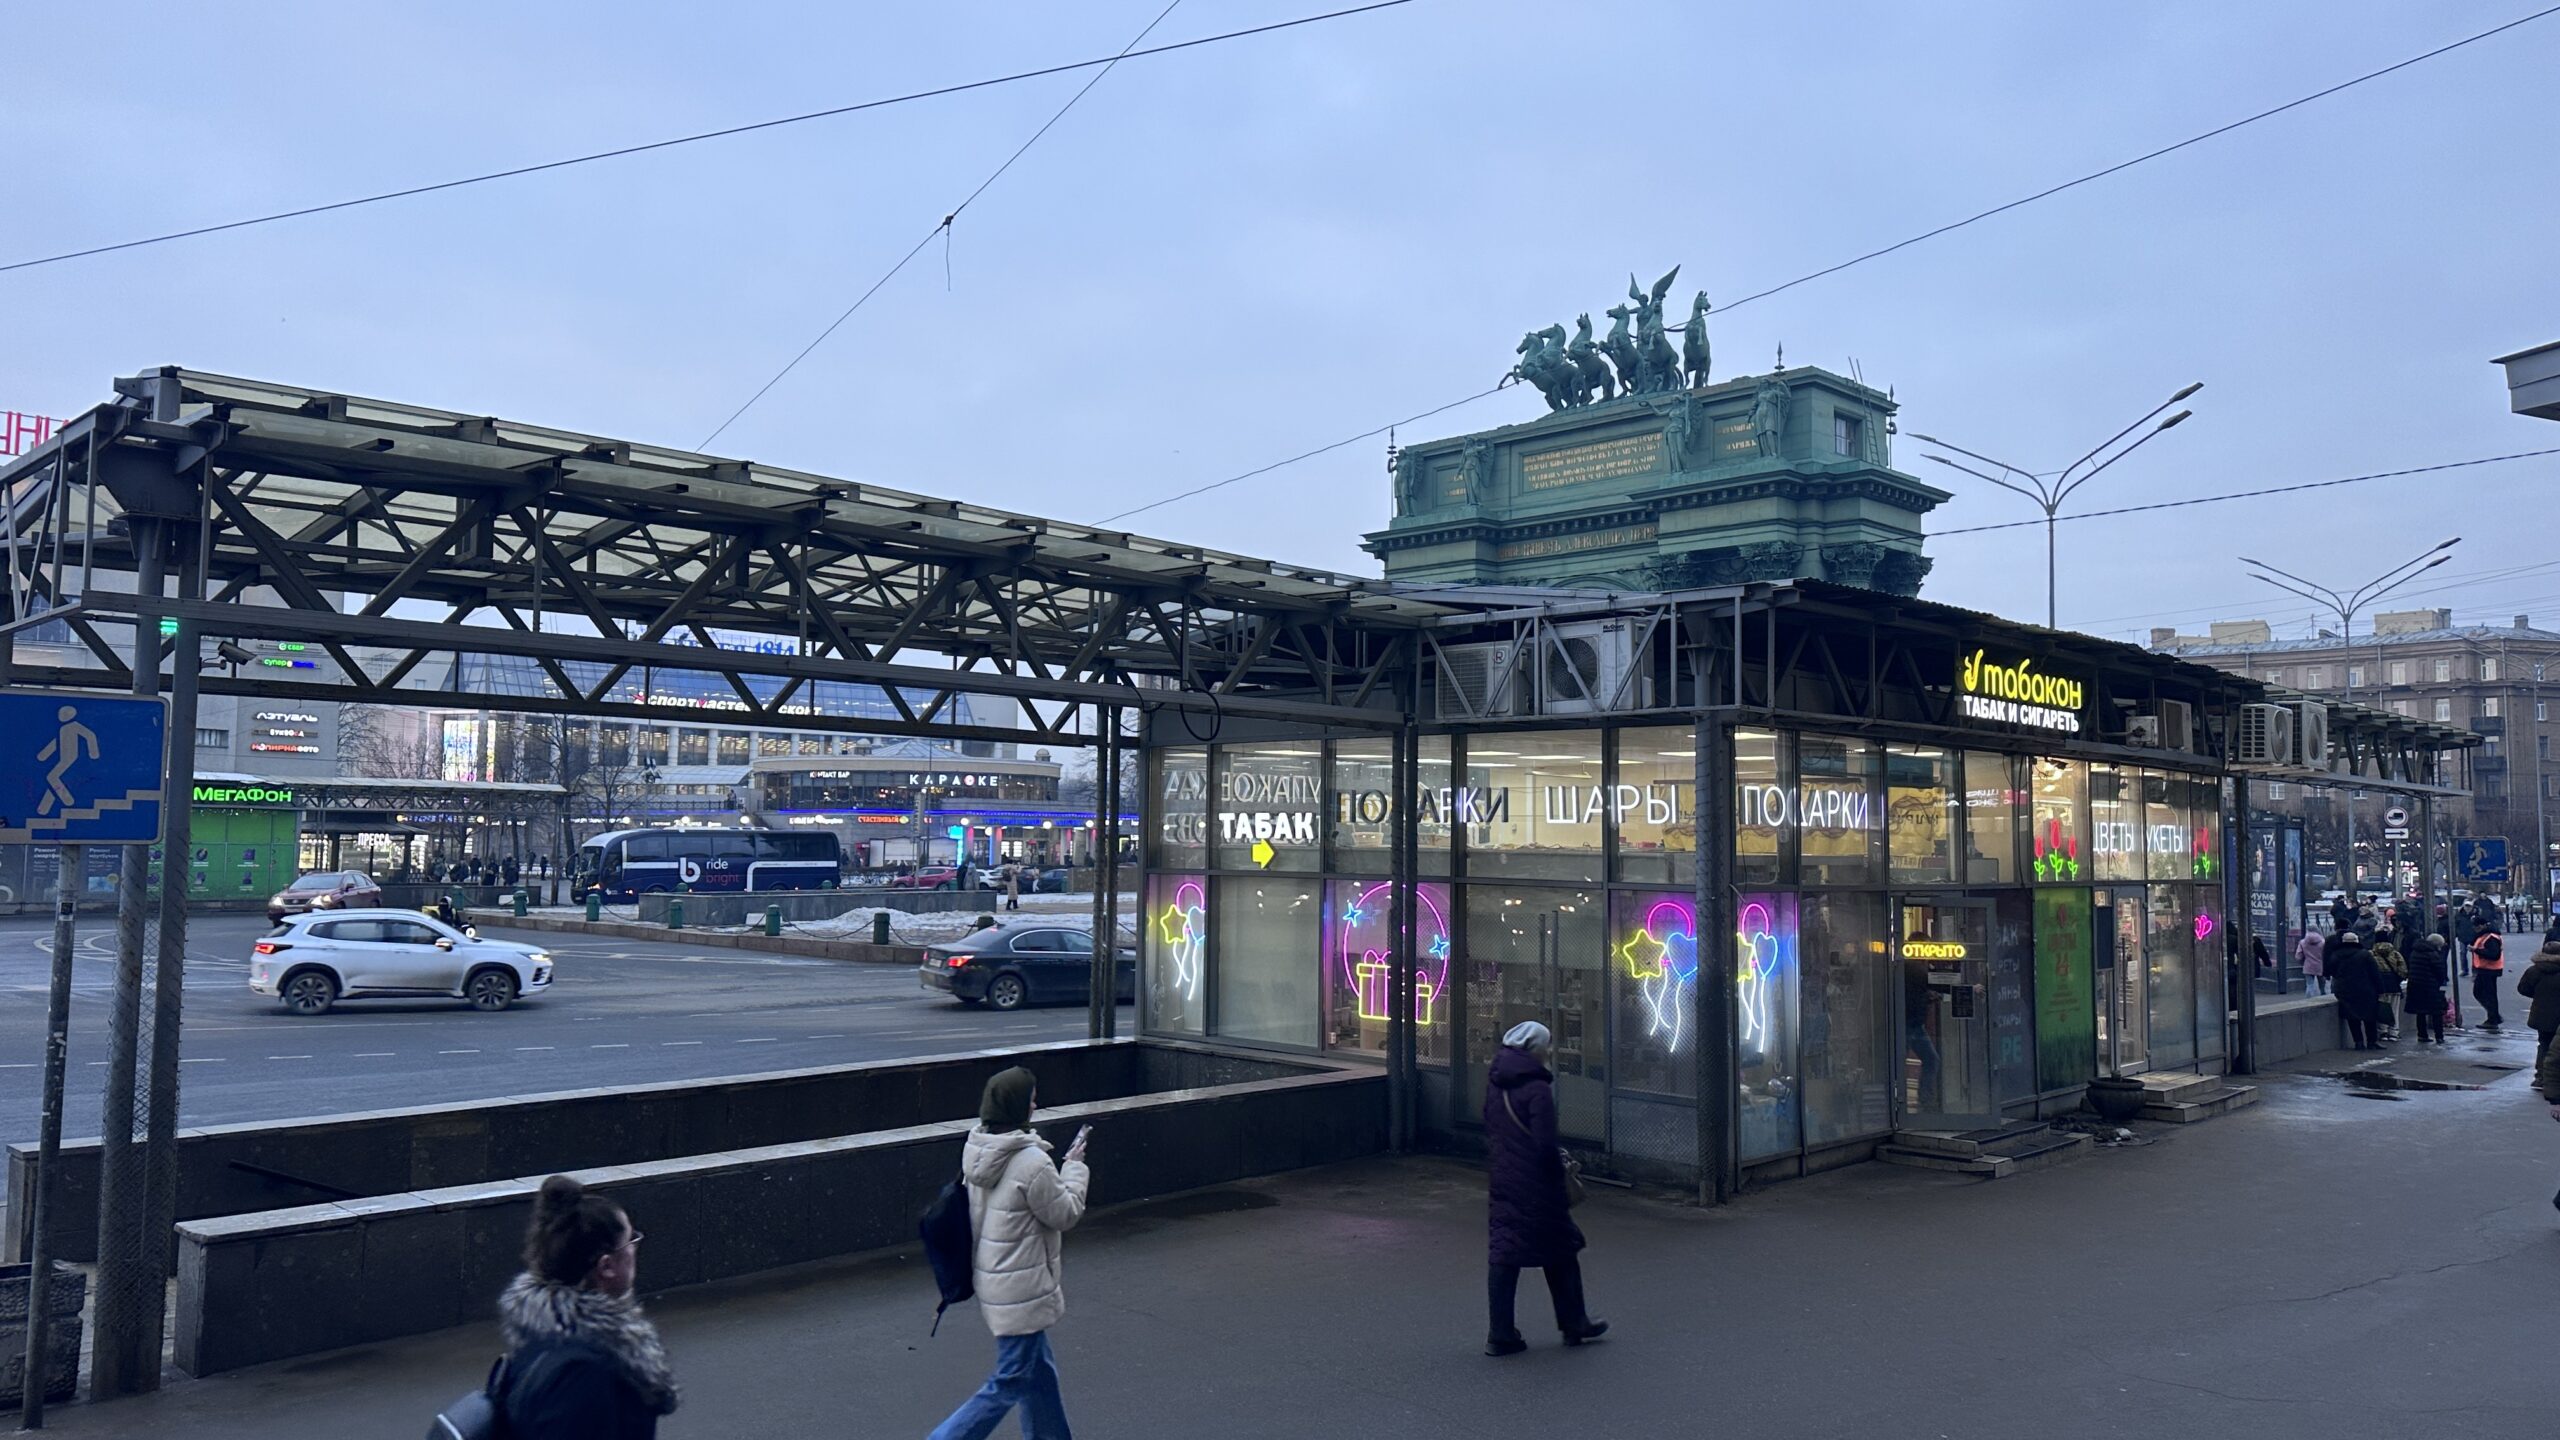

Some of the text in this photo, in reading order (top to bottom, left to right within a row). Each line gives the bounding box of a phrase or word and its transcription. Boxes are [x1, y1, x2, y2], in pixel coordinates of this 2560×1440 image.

[1984, 658, 2082, 710] табакон
[1963, 695, 2006, 722] ТАБАК
[2008, 702, 2018, 724] И
[909, 774, 999, 787] КАРАОКЕ
[1336, 785, 1509, 825] ПОАРКИ
[1544, 784, 1677, 825] ШАРЫ
[357, 833, 392, 846] ПРЕССА
[1218, 812, 1314, 842] ТАБАК
[2092, 821, 2135, 855] ЦВЕТЫ
[705, 858, 729, 870] ride
[705, 873, 739, 886] bright
[1901, 943, 1967, 959] ОТКРЫТО
